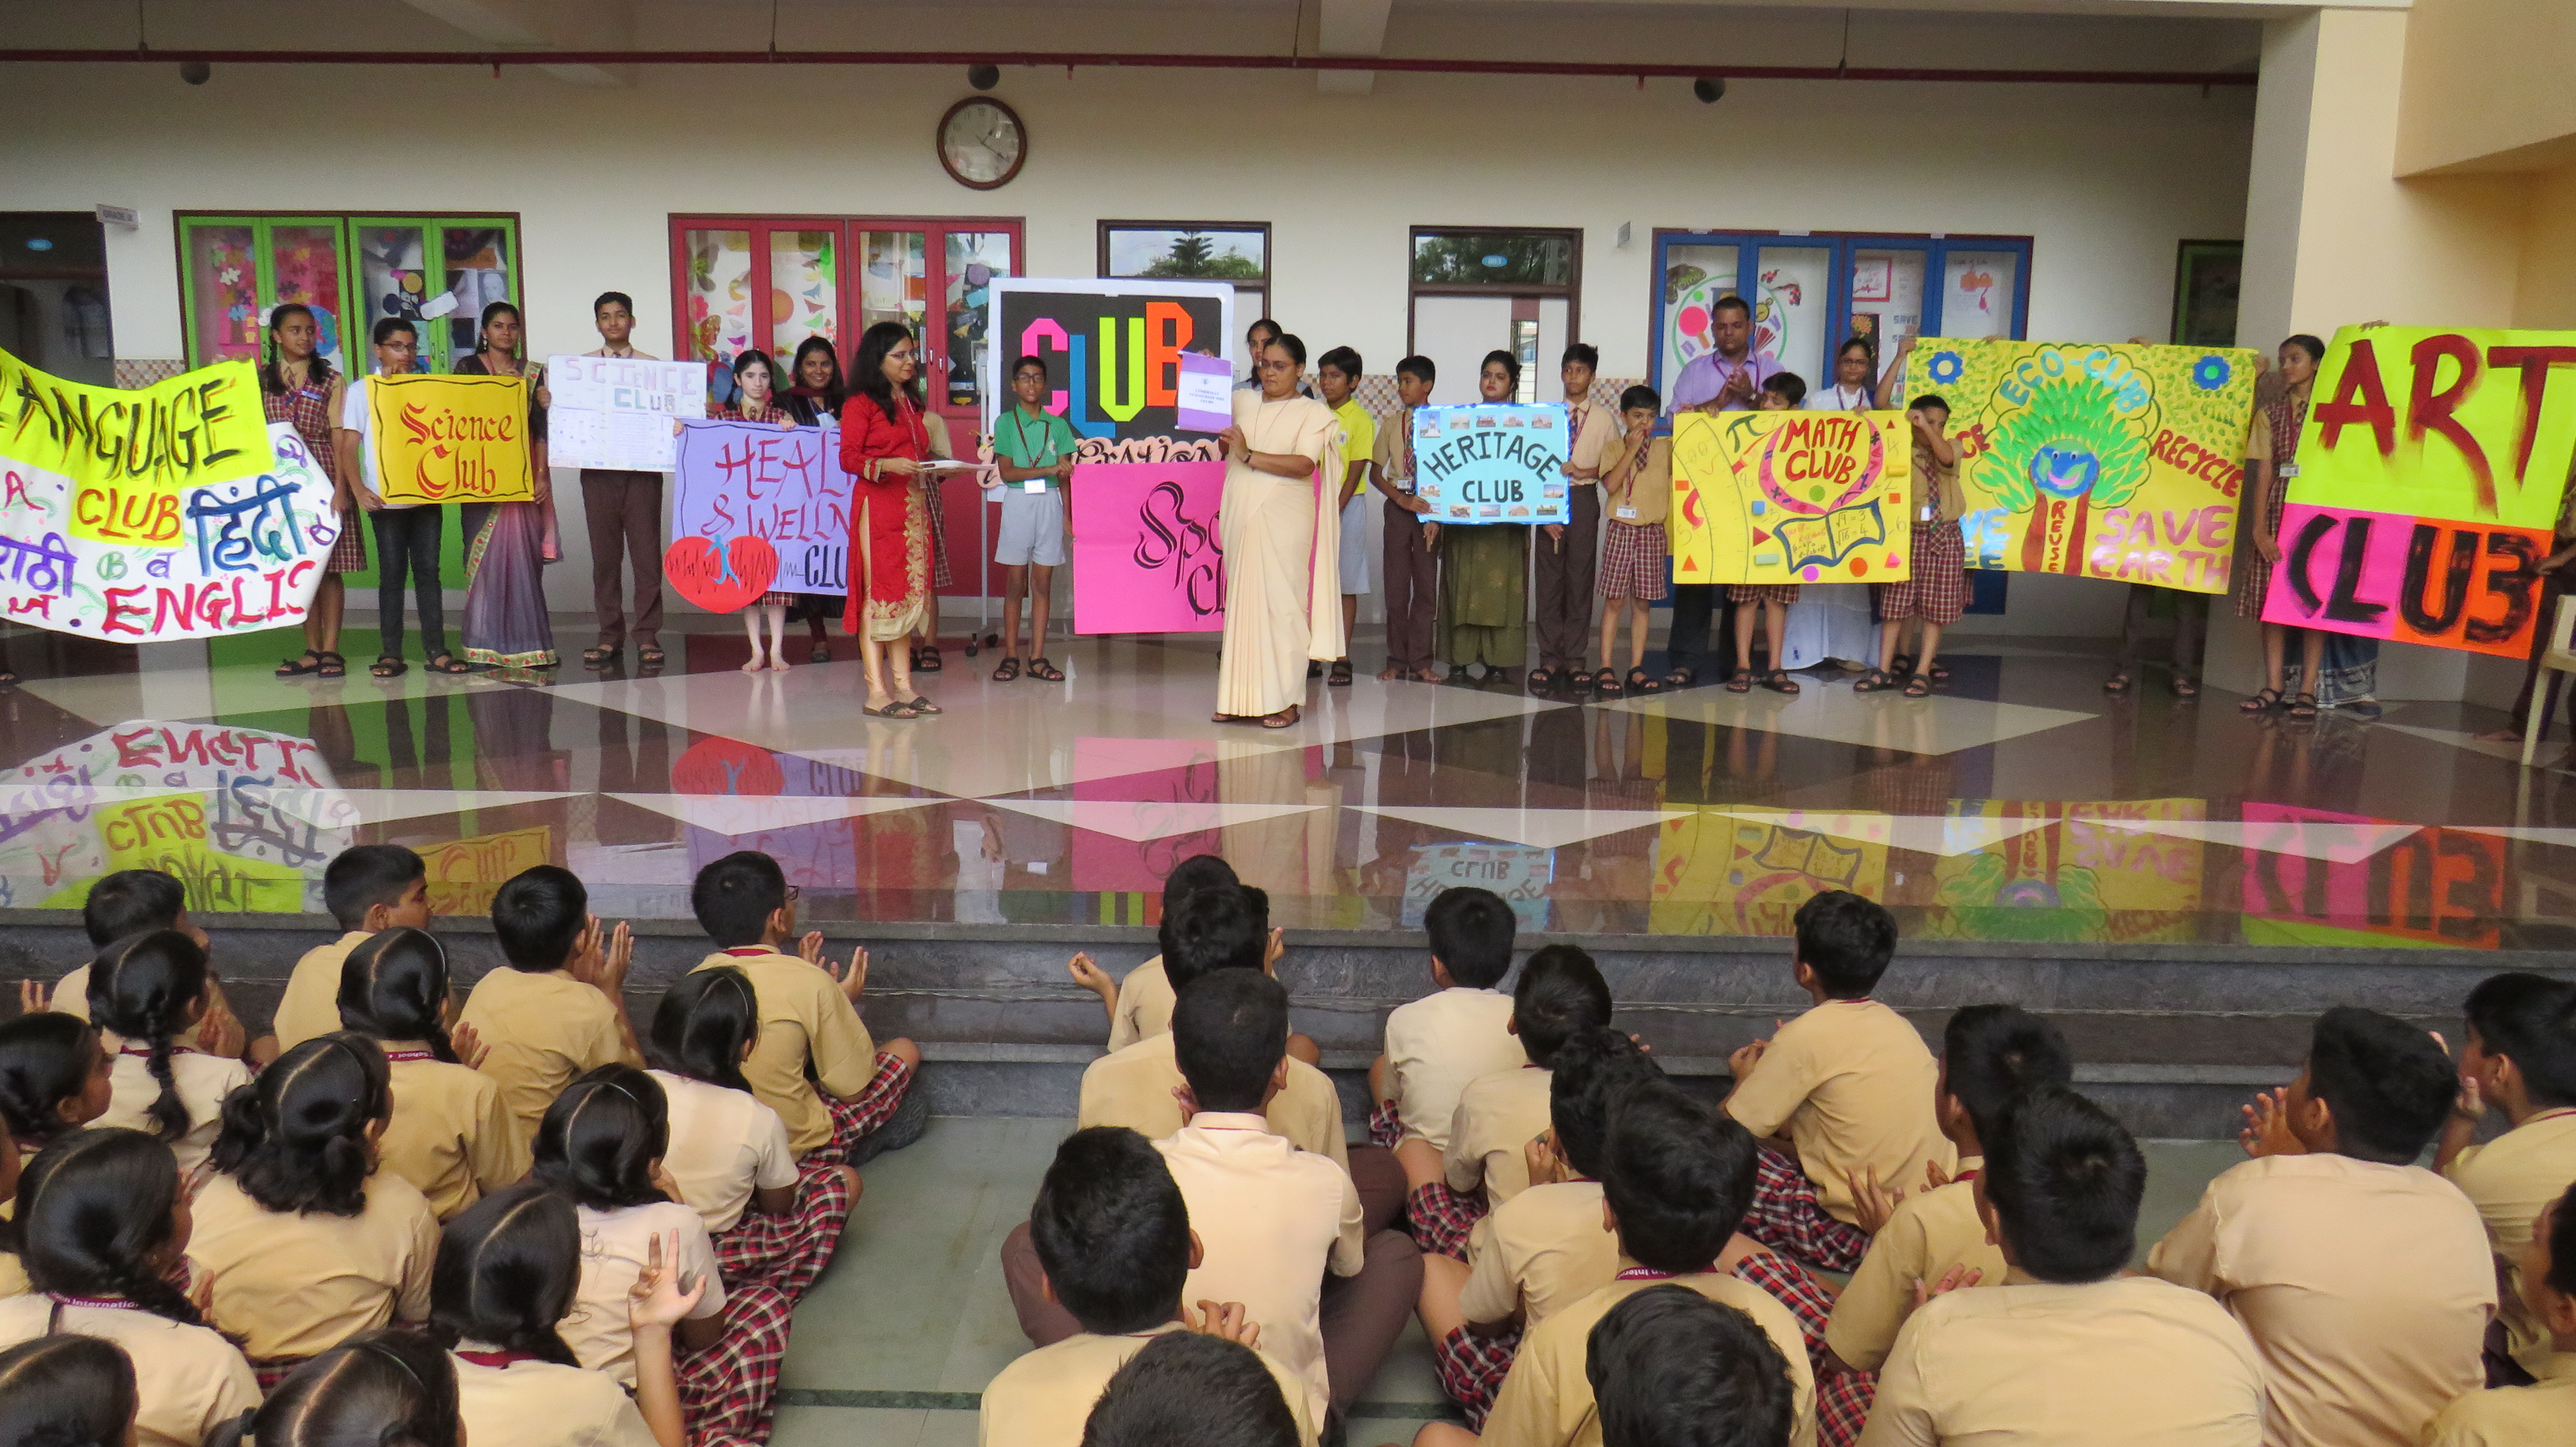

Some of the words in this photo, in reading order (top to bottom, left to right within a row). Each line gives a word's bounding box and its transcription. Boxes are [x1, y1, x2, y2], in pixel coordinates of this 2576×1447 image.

[565, 356, 698, 396] SCIENCE
[1022, 302, 1193, 439] CLUB
[0, 367, 247, 487] ANGUAGE
[400, 402, 516, 448] Science
[614, 387, 676, 413] CLUB
[2313, 334, 2576, 519] ART
[1423, 431, 1563, 482] HERITAGE
[1780, 418, 1862, 453] MATH
[416, 443, 496, 497] Club
[715, 431, 851, 500] HEAL
[1785, 450, 1856, 484] CLUB
[2150, 429, 2245, 497] RECYCLE
[77, 487, 180, 541] CLUB
[1462, 480, 1524, 503] CLUB
[186, 475, 302, 577] हिंदी
[2048, 499, 2068, 572] REUSE
[2095, 505, 2235, 548] SAVE
[2090, 546, 2233, 590] EARTH
[2287, 513, 2539, 643] CLUB
